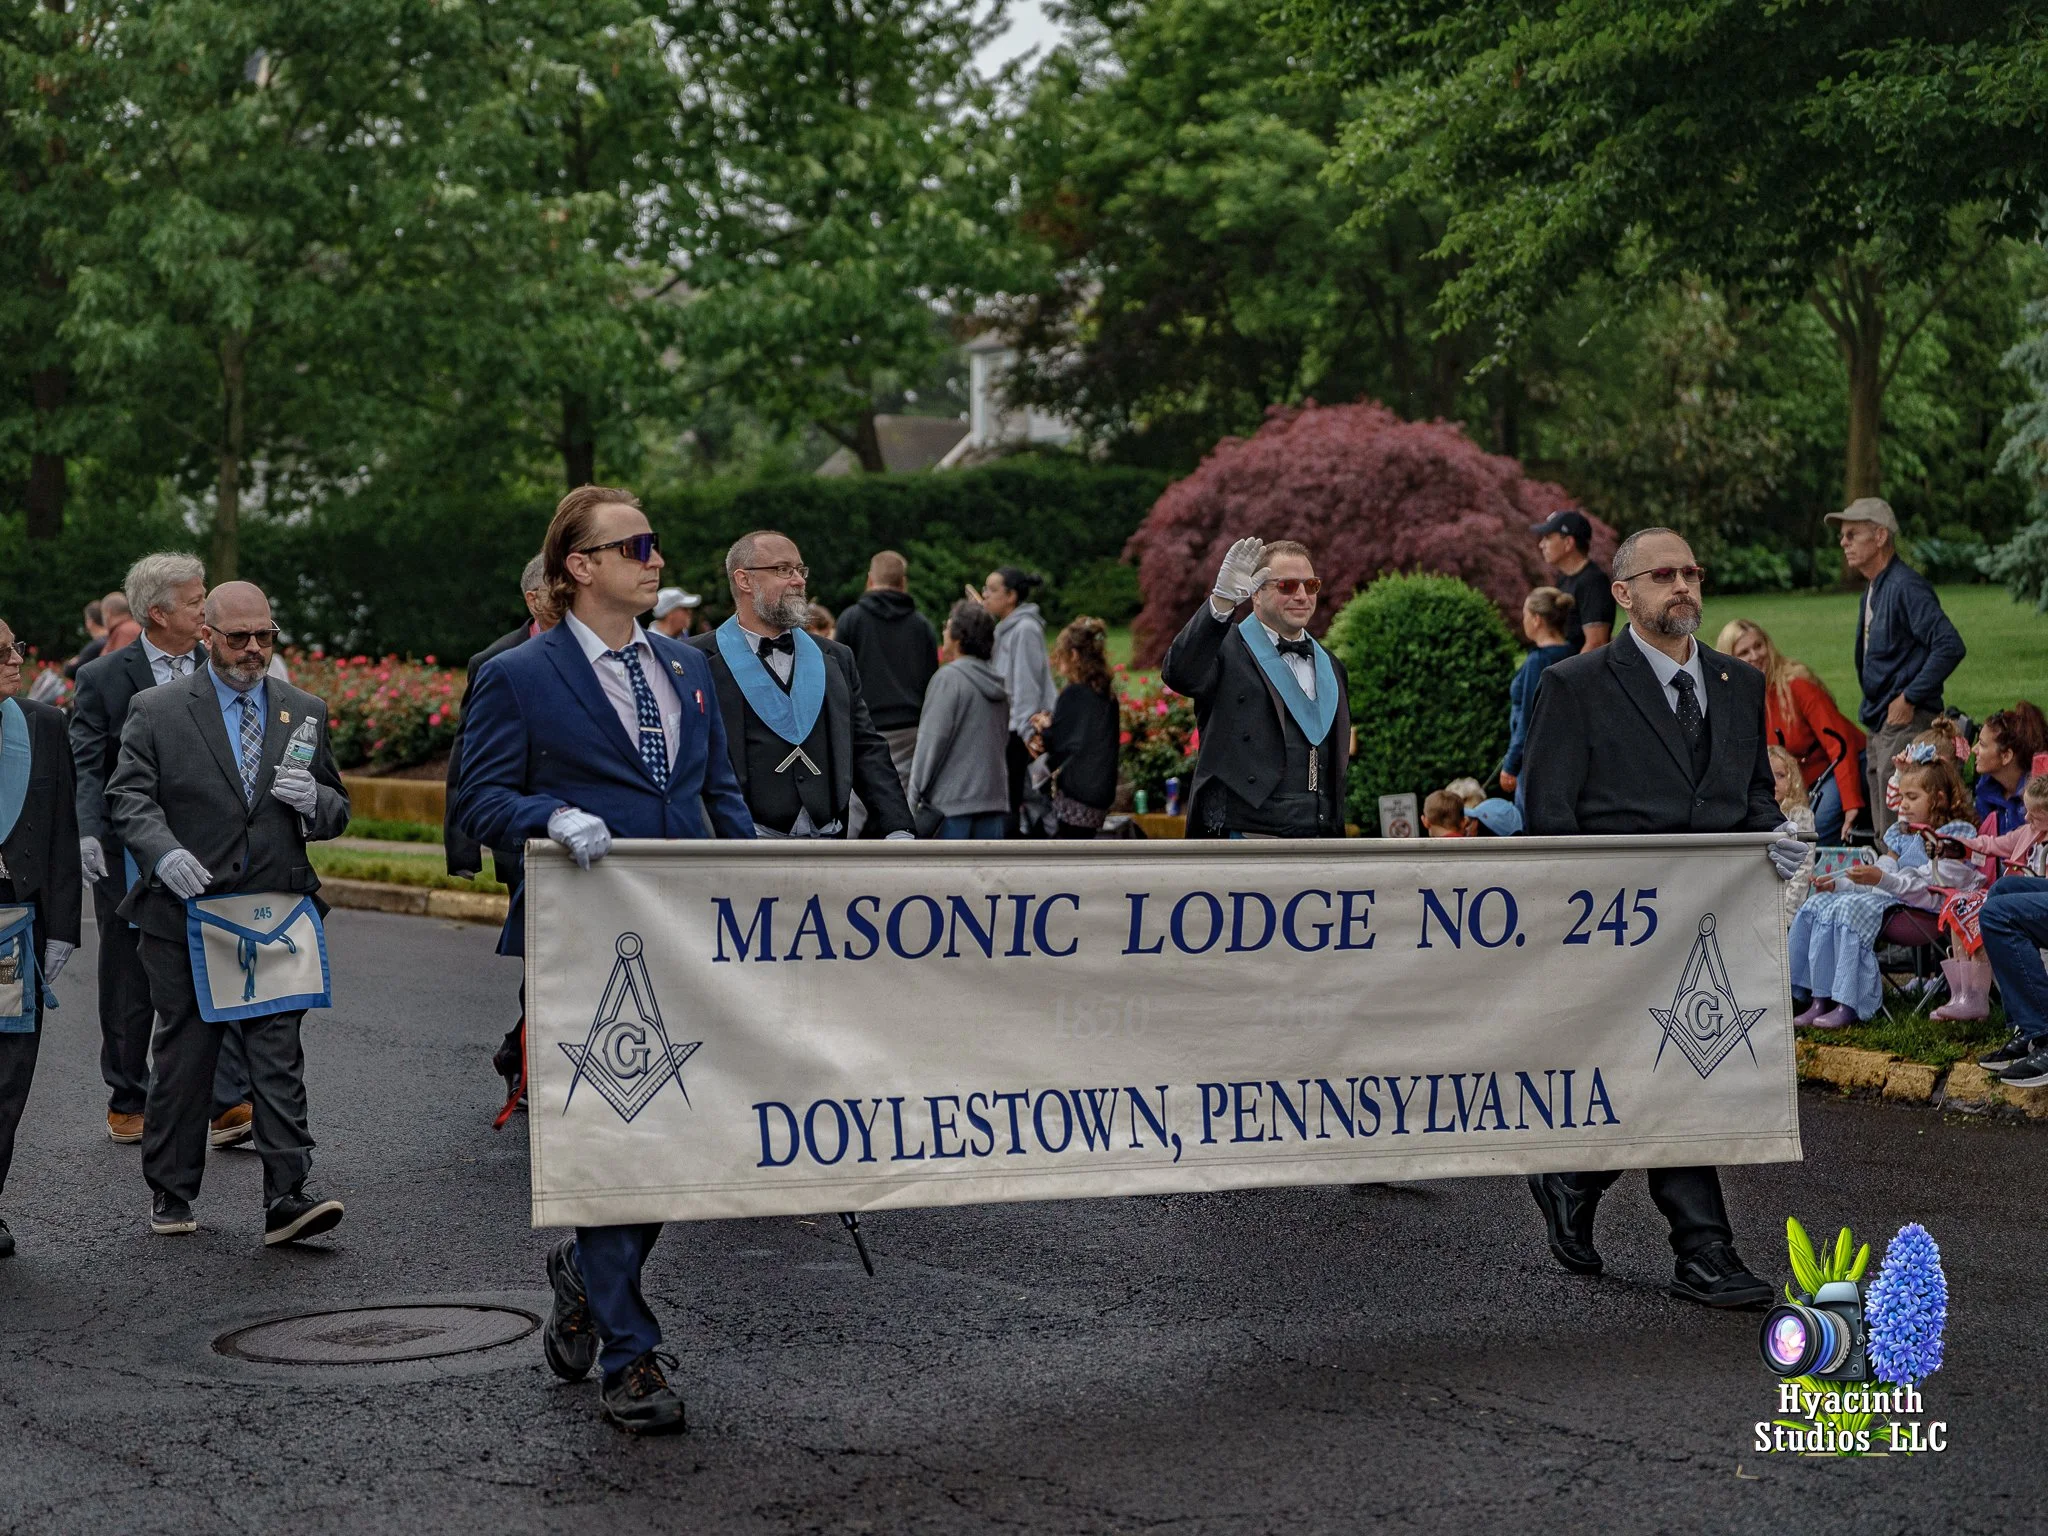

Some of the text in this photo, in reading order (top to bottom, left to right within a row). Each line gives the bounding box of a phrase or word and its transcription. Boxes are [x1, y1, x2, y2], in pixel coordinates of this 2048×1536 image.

[253, 906, 273, 921] 245
[712, 887, 1658, 962] MASONIC LODGE NO. 245
[1685, 990, 1724, 1041] G
[602, 1022, 651, 1080] G
[752, 1068, 1620, 1167] DOYLESTOWN, PENNSYLVANIA
